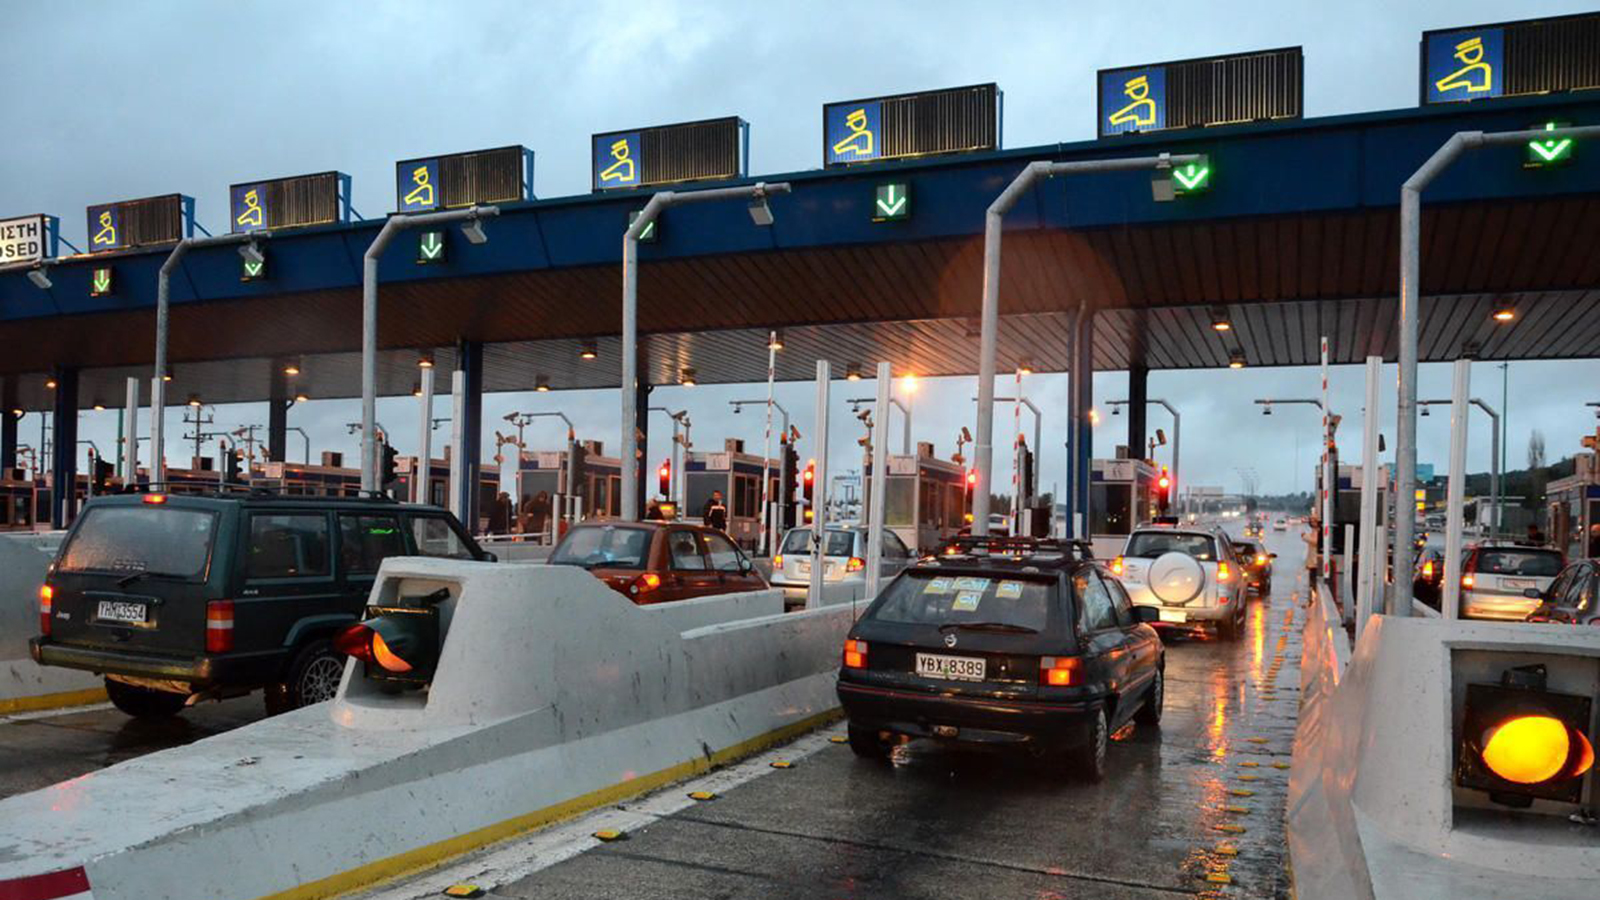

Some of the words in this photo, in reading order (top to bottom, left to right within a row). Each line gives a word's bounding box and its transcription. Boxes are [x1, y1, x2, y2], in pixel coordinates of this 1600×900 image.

[121, 603, 144, 619] 3554
[920, 656, 942, 672] YBX
[949, 659, 983, 676] 8389
